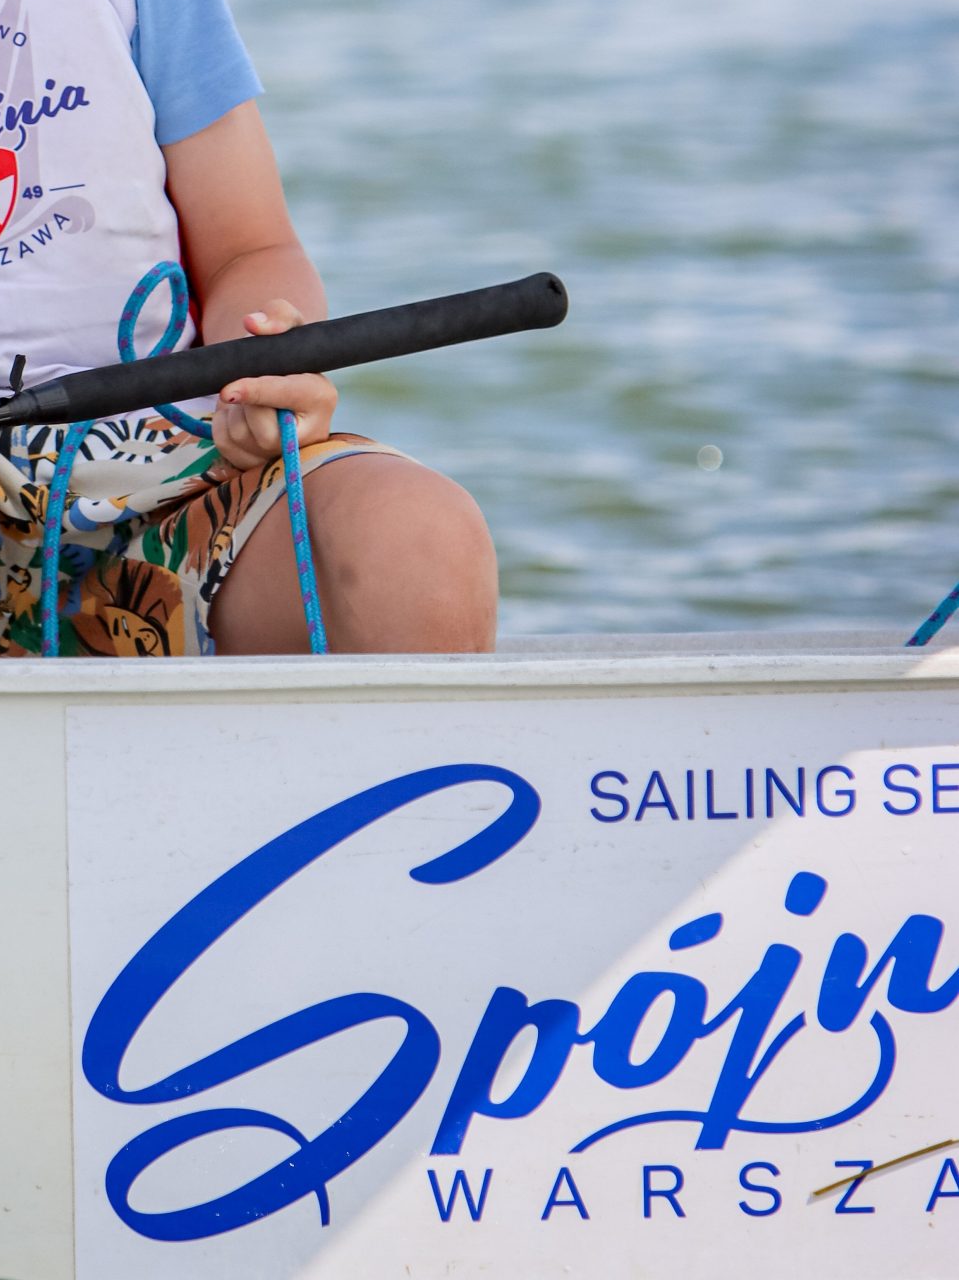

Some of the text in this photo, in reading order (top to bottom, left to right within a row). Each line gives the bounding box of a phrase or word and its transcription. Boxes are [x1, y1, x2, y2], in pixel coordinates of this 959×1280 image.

[21, 184, 44, 200] 49
[590, 763, 959, 822] SAILING SE
[427, 1157, 959, 1223] WARSZA
